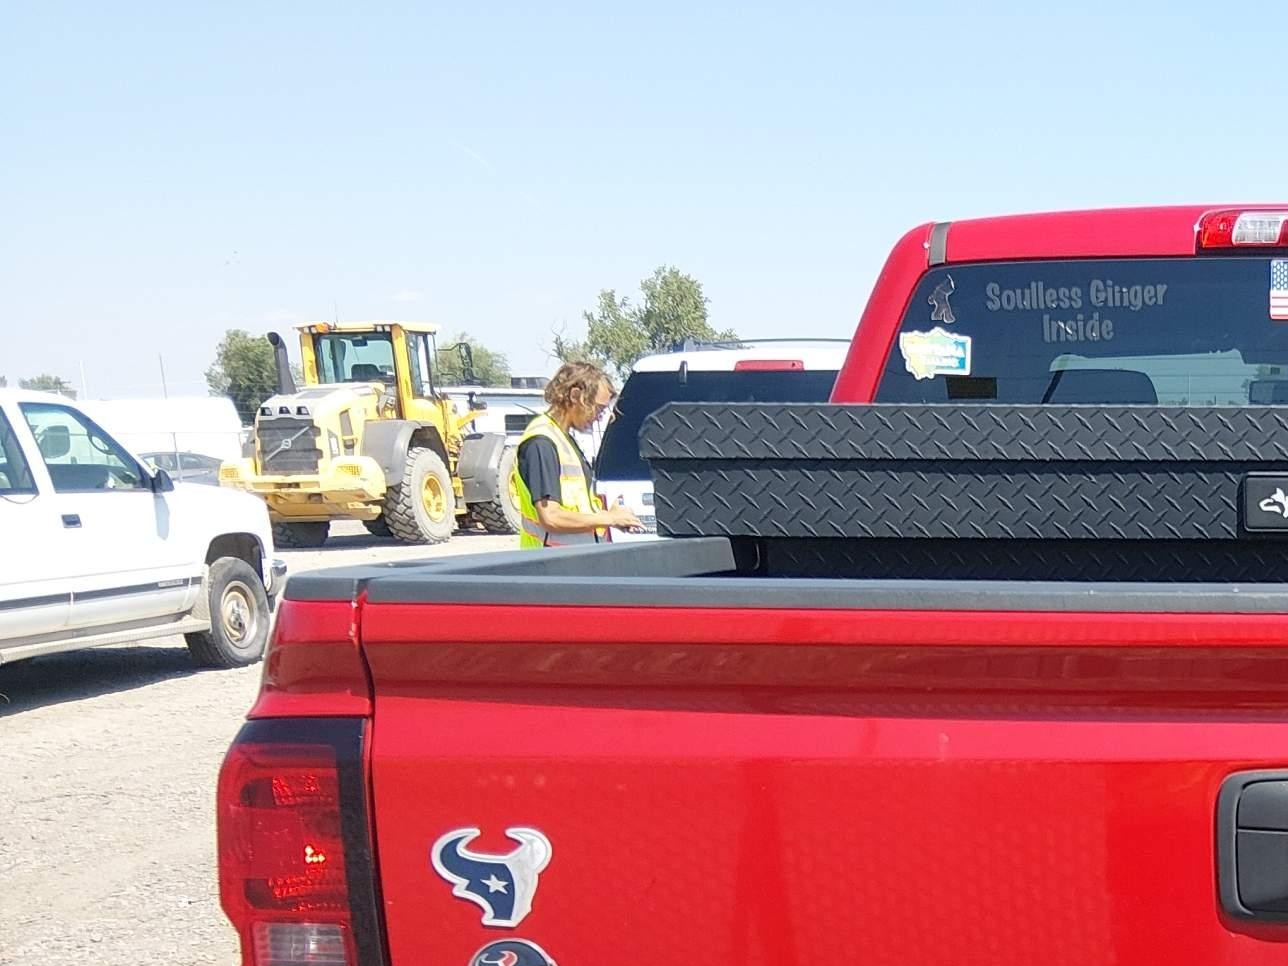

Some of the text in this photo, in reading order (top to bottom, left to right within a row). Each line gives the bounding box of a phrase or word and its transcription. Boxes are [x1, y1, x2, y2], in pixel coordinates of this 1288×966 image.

[985, 279, 1168, 311] Soulless Ginger
[1042, 312, 1115, 343] Inside
